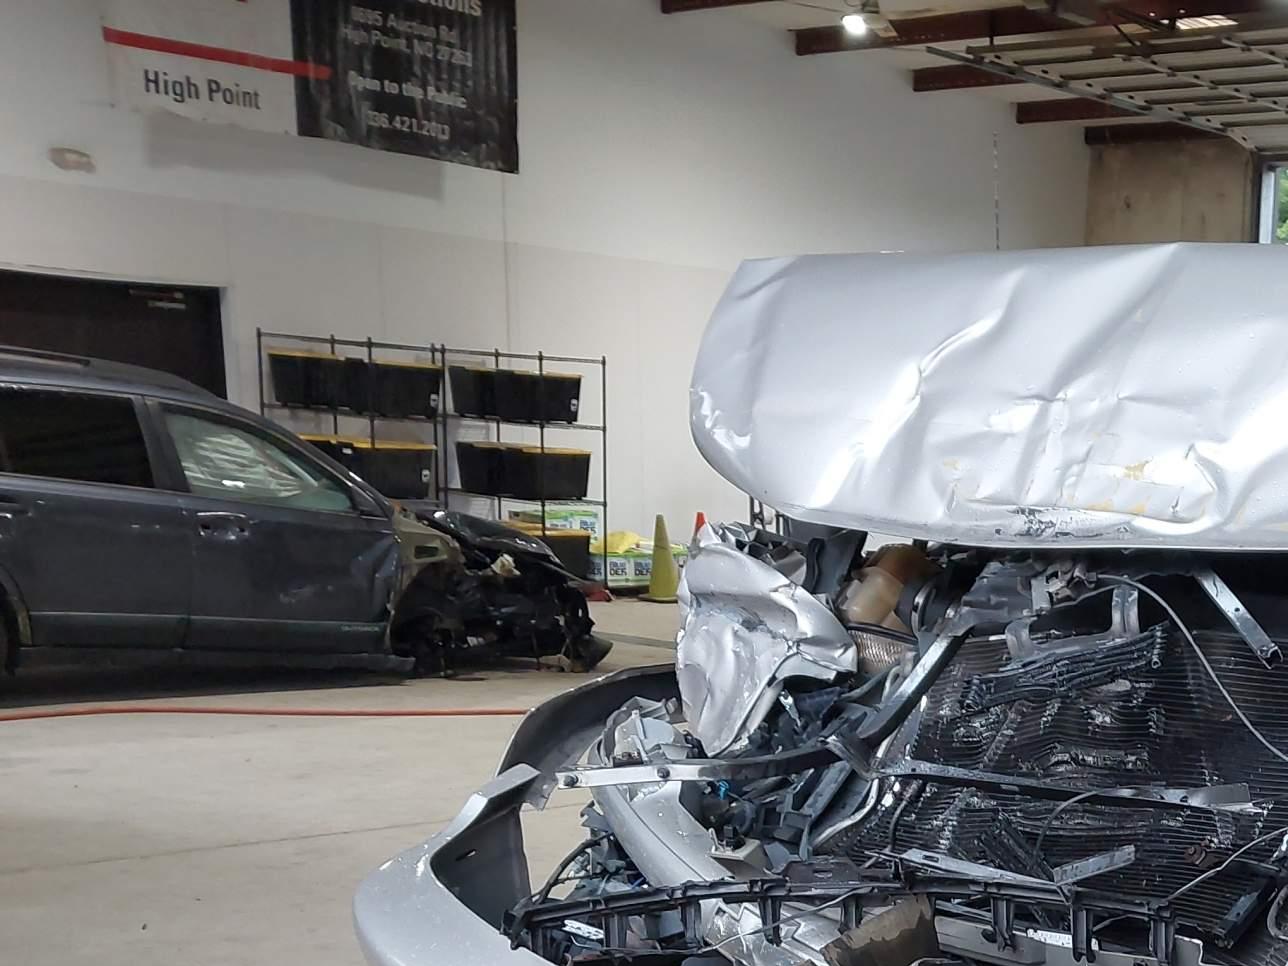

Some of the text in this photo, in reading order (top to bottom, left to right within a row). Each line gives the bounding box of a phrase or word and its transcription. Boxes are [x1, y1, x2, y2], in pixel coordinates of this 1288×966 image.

[144, 69, 262, 110] High Point
[384, 80, 399, 94] to
[402, 82, 424, 99] the
[427, 86, 468, 108] Public
